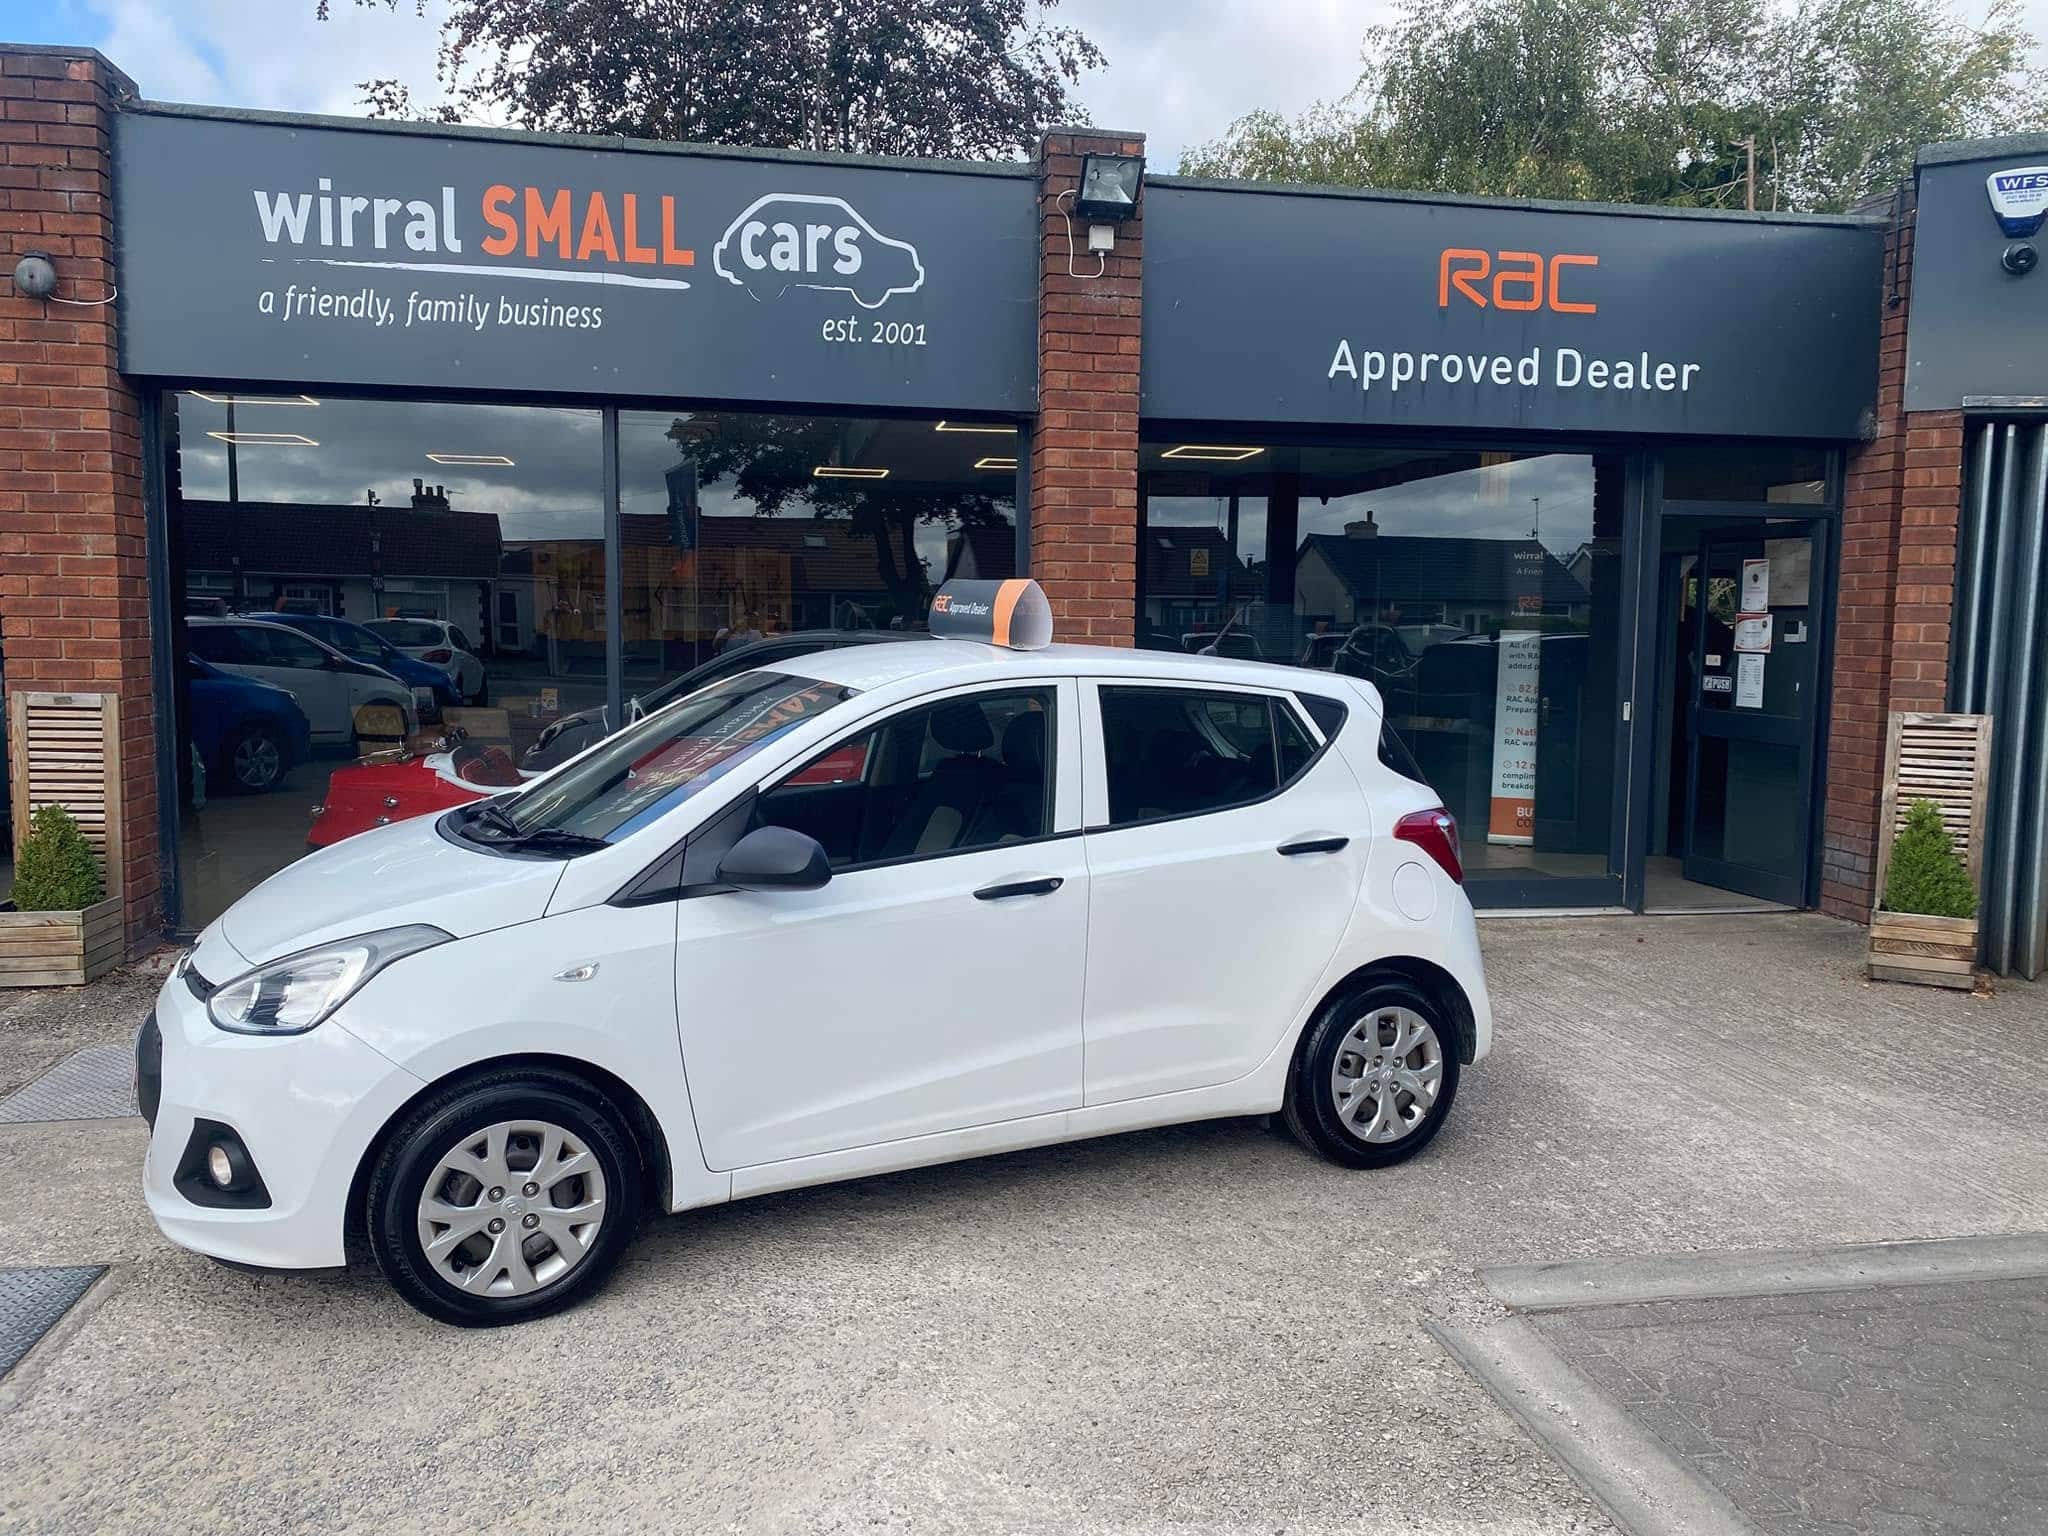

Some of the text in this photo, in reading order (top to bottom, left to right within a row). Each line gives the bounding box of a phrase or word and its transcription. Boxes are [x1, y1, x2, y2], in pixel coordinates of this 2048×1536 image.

[254, 178, 862, 275] wirral SMALL cars
[259, 284, 602, 332] a friendly, family business
[822, 315, 927, 346] est. 2001
[1327, 338, 1701, 392] Approved Dealer
[1513, 551, 1544, 561] wirral
[1506, 695, 1523, 704] RAC
[1504, 738, 1521, 747] RAC
[1515, 761, 1527, 770] 12
